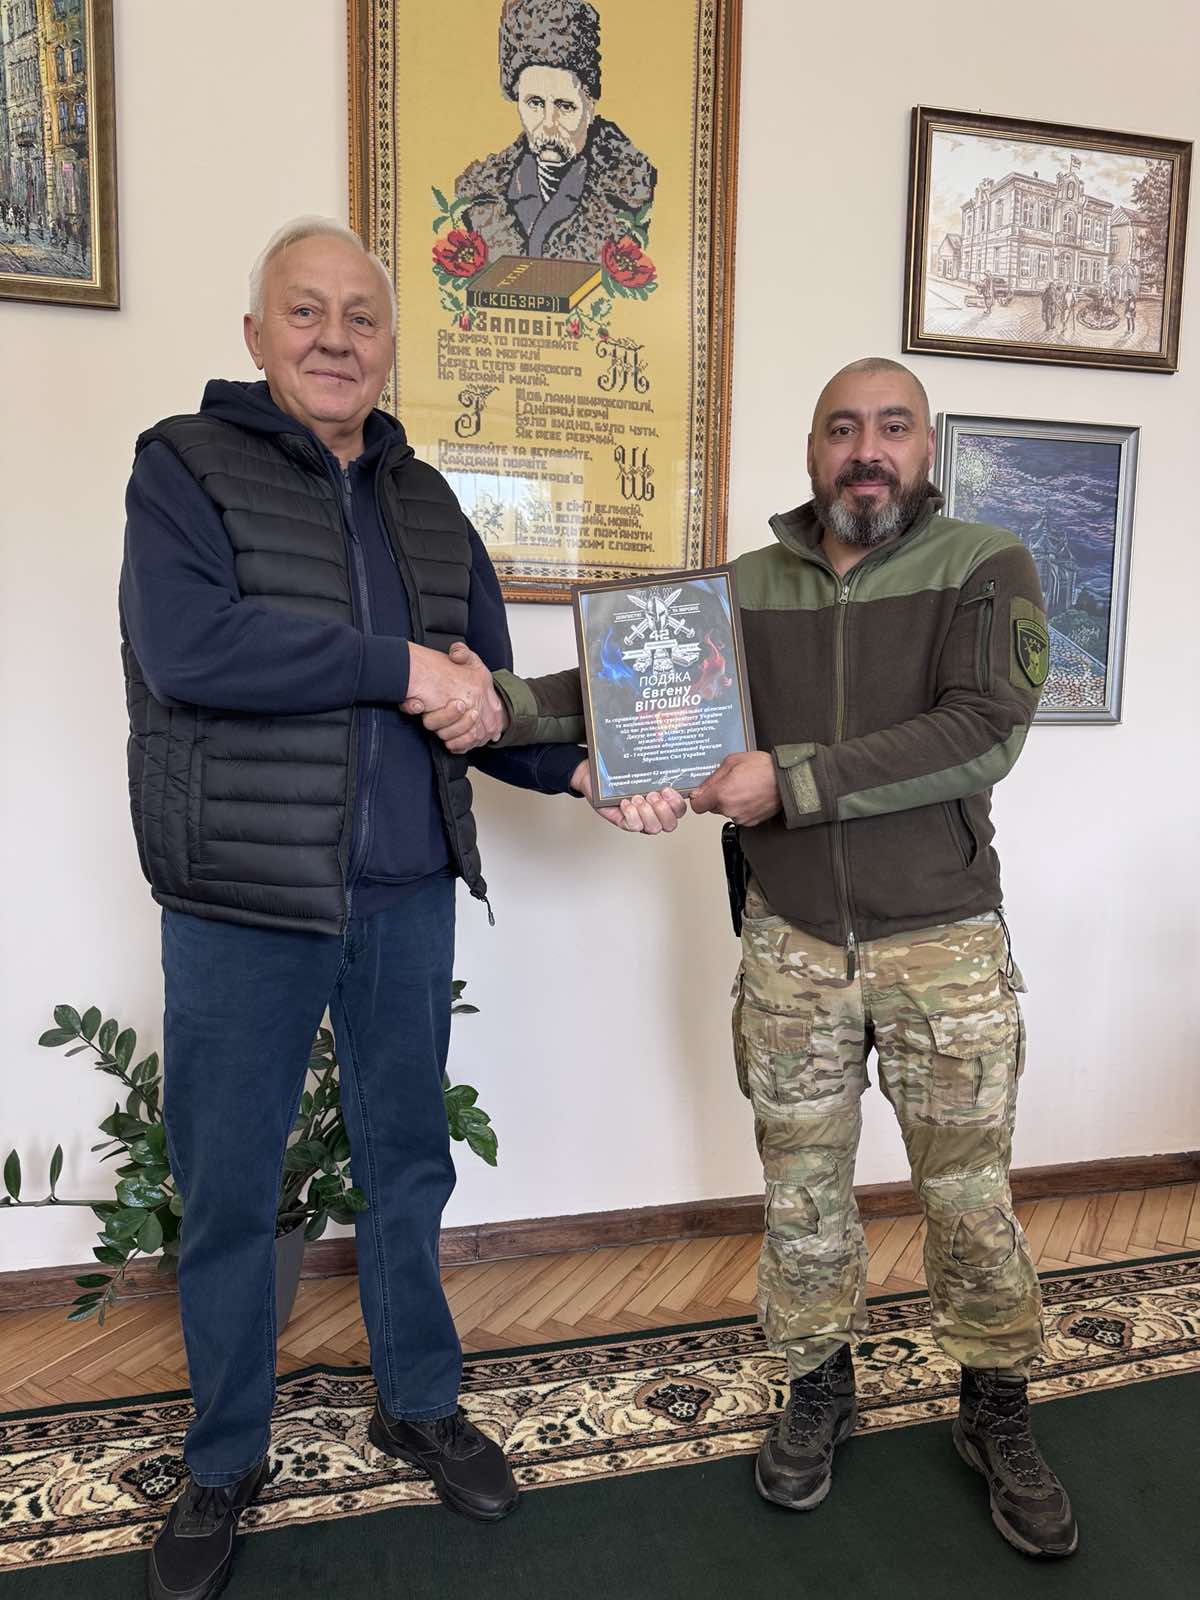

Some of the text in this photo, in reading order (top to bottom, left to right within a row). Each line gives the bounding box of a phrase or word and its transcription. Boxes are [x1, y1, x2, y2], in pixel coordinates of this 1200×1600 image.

[476, 347, 492, 358] НА
[512, 445, 526, 456] ТА
[649, 630, 670, 641] 42
[640, 671, 691, 687] ПОДЯКА
[642, 685, 691, 699] Євгену
[635, 694, 701, 712] ВІТОШКО
